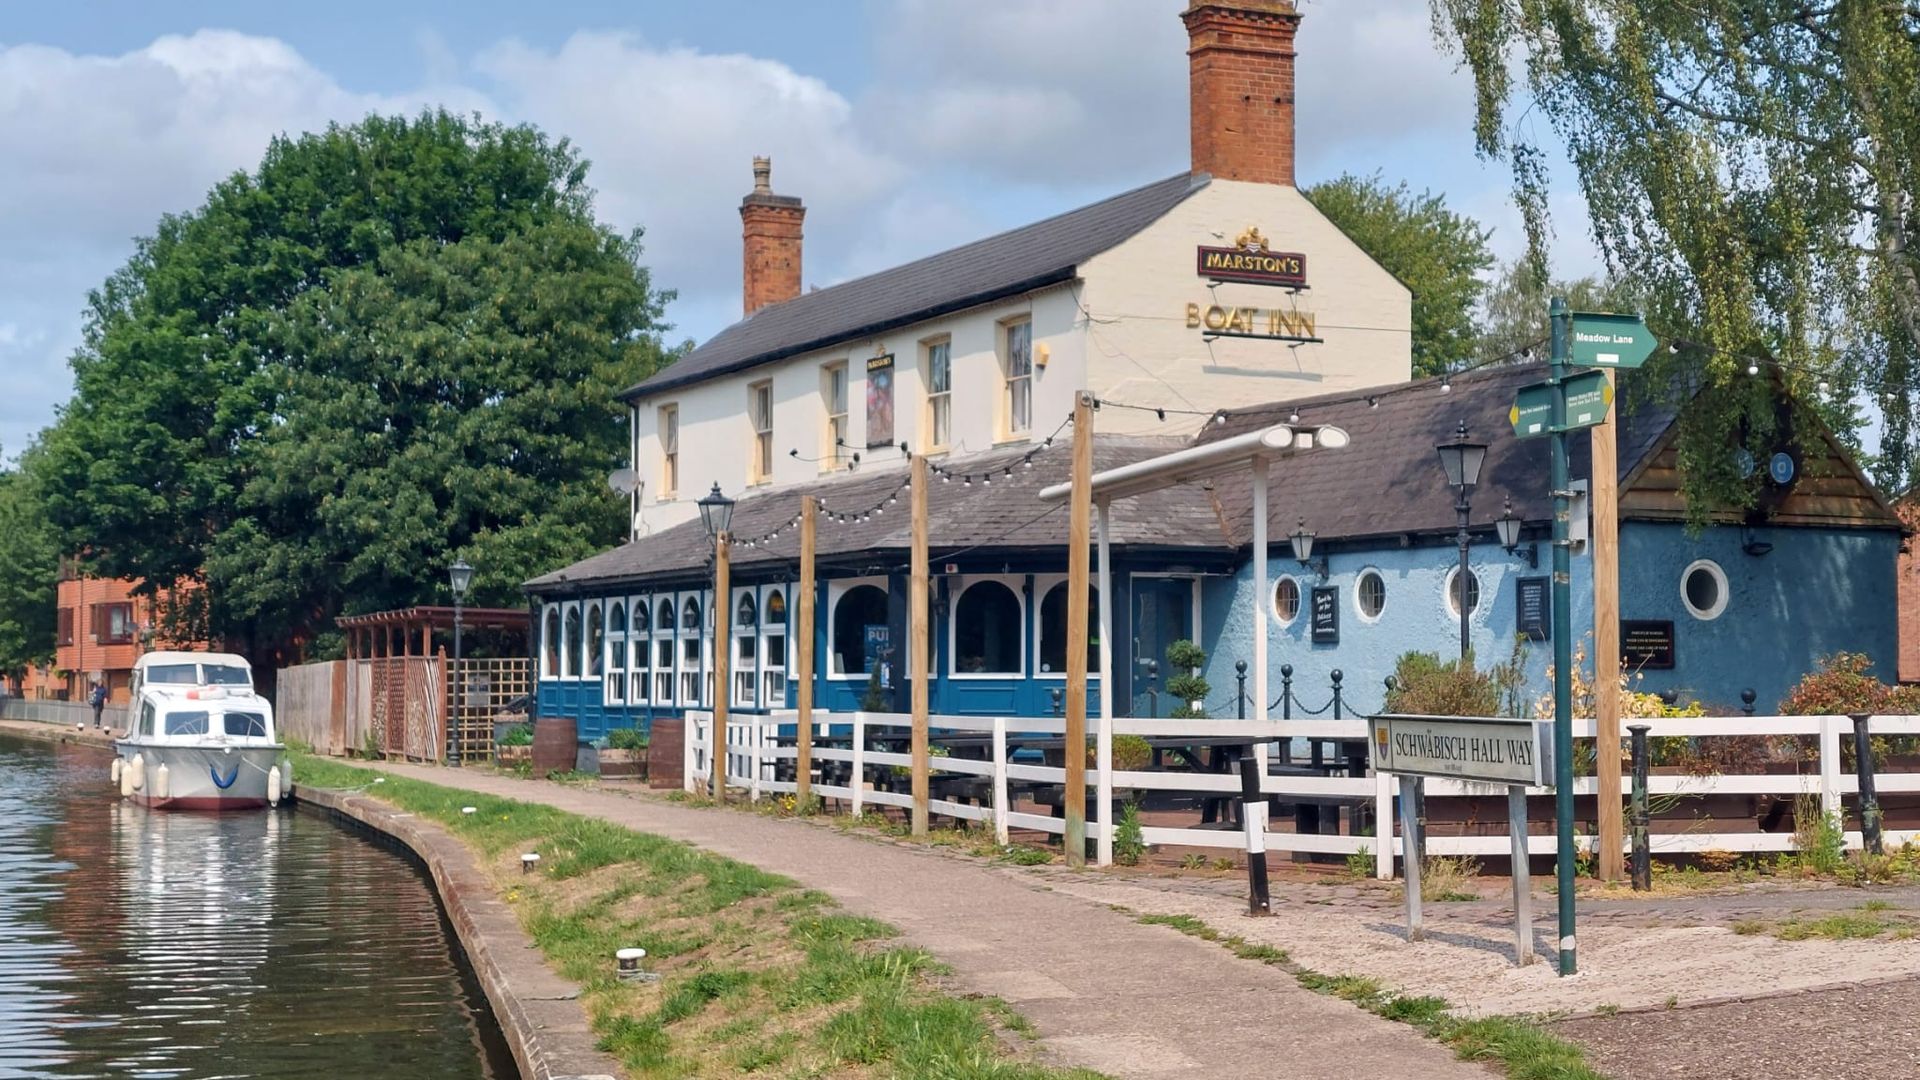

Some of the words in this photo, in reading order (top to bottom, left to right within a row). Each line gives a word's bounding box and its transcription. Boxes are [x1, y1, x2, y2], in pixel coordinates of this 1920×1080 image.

[1207, 253, 1300, 273] MARSTON'S
[1186, 302, 1258, 332] BOAT
[1268, 308, 1316, 338] INN
[1576, 332, 1610, 343] Meadow
[1613, 334, 1633, 344] Lane
[1395, 729, 1467, 761] SCHWÄBISCH
[1471, 738, 1504, 764] HALL
[1507, 740, 1533, 766] WAY
